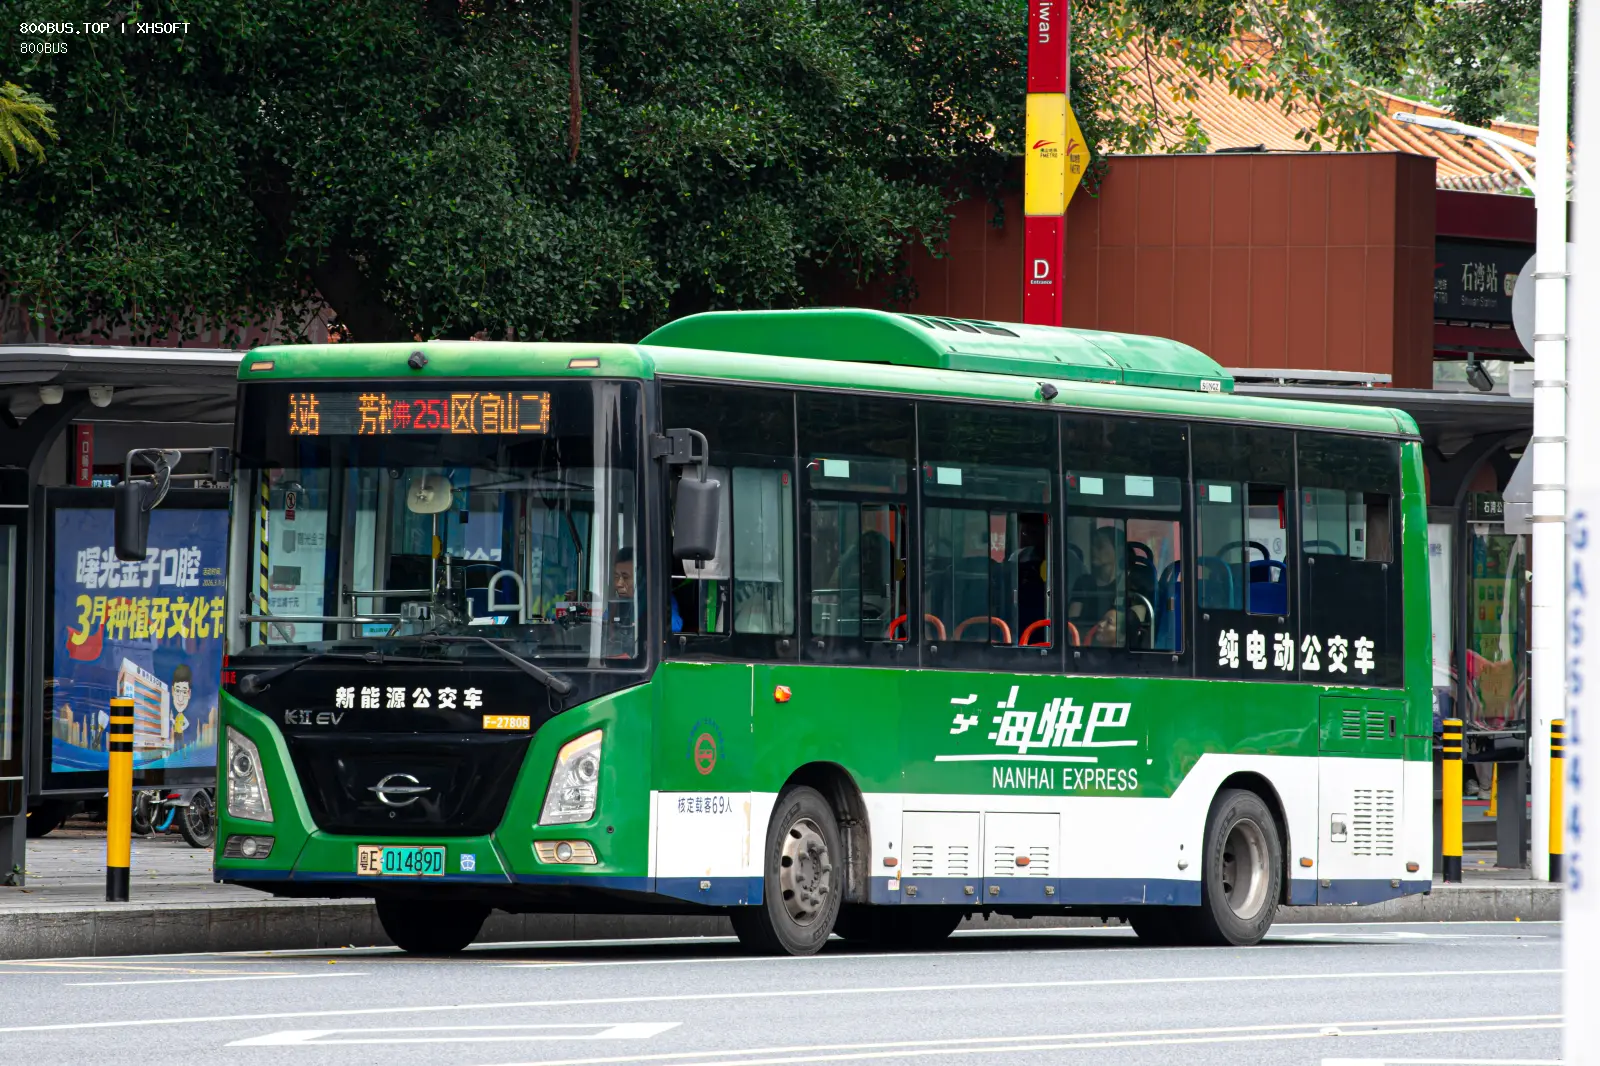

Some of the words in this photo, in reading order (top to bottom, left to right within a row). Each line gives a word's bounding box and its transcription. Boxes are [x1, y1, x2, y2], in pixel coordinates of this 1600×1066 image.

[1034, 259, 1049, 278] D
[1461, 262, 1498, 293] 石湾站
[71, 594, 225, 646] 3月种植牙文化节
[1218, 629, 1375, 674] 纯电动公交车
[335, 686, 483, 709] 新能源公交车
[316, 711, 344, 725] EV
[483, 716, 530, 729] F-27808
[992, 766, 1054, 789] NANHAI
[1063, 768, 1138, 791] EXPRESS
[678, 796, 733, 814] 核定载客69人
